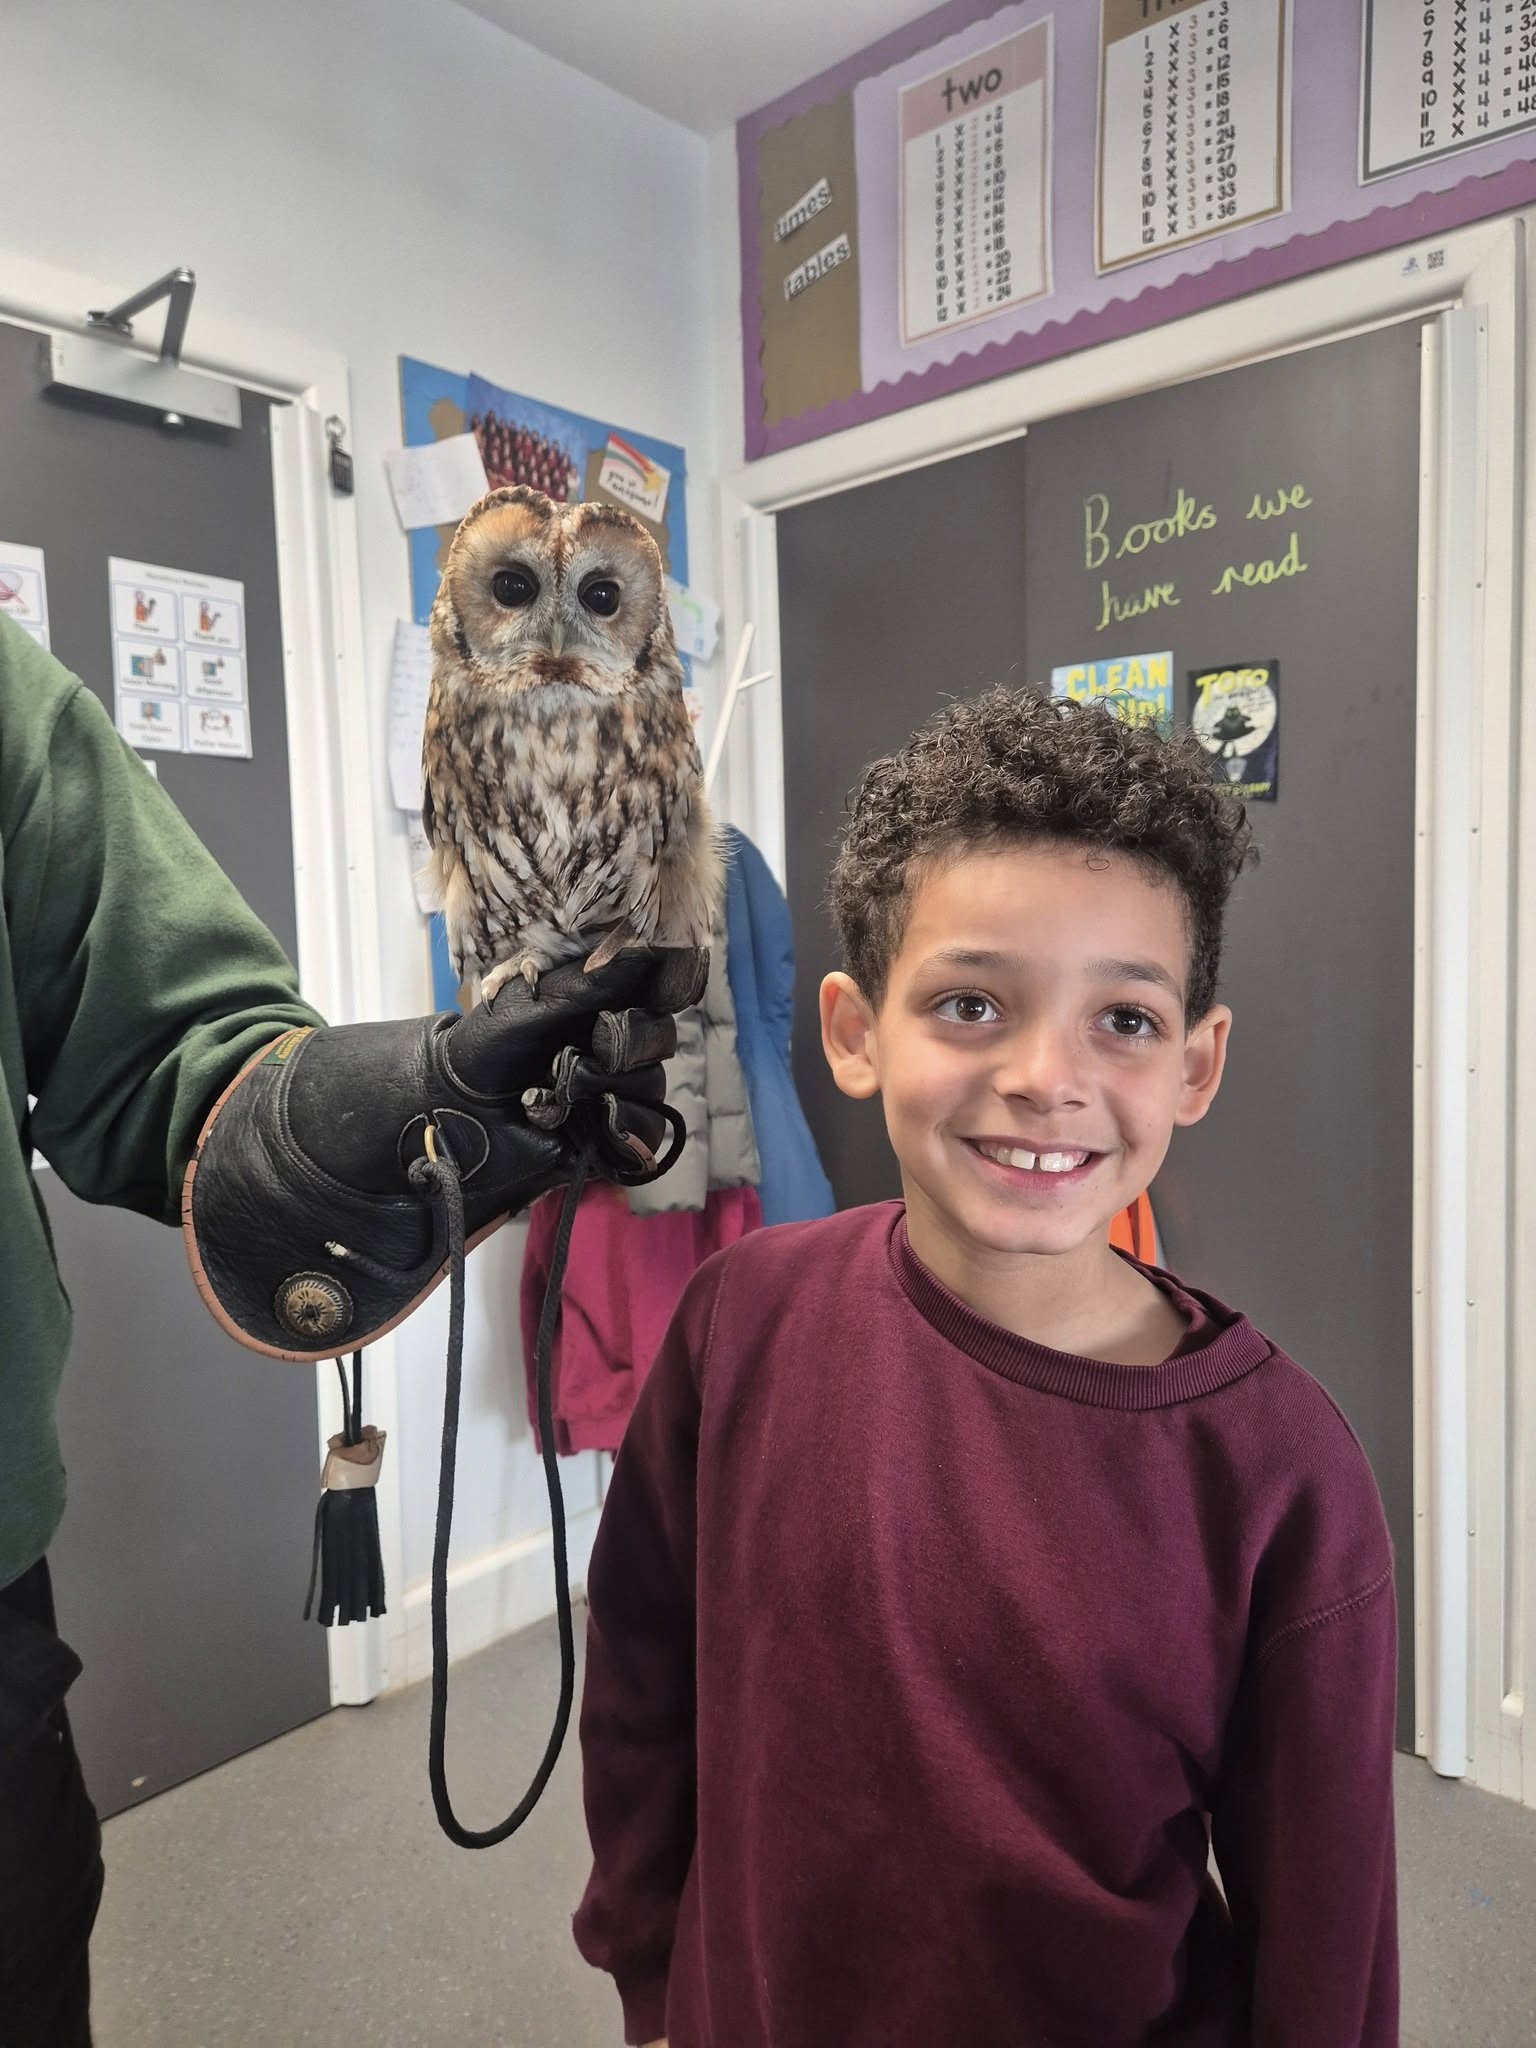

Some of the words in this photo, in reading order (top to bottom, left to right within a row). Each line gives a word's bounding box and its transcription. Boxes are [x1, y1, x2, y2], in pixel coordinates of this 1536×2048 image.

[1189, 14, 1198, 29] 3
[1219, 0, 1229, 16] 3
[1423, 9, 1435, 26] 6
[1423, 30, 1433, 47] 7
[1480, 8, 1491, 24] 4
[1144, 69, 1153, 84] 3
[1187, 50, 1196, 65] 3
[1218, 36, 1228, 51] 9
[1145, 52, 1154, 66] 2
[1188, 32, 1197, 47] 3
[1218, 18, 1229, 34] 6
[1422, 50, 1433, 67] 8
[1479, 28, 1491, 45] 4
[1144, 86, 1153, 100] 4
[1187, 68, 1196, 83] 3
[1217, 53, 1231, 72] 12
[1421, 89, 1437, 108] 10
[1478, 70, 1490, 86] 4
[1422, 69, 1434, 86] 9
[1479, 49, 1491, 66] 4
[941, 68, 1003, 113] two
[1143, 103, 1152, 119] 5
[1186, 86, 1196, 101] 3
[1217, 72, 1230, 90] 15
[1143, 121, 1152, 136] 6
[1186, 104, 1195, 119] 3
[1216, 90, 1230, 108] 18
[1421, 111, 1429, 128] 11
[1478, 91, 1489, 107] 4
[1142, 138, 1151, 154] 7
[1186, 122, 1195, 137] 3
[1216, 108, 1230, 126] 21
[1142, 156, 1152, 172] 8
[1186, 140, 1195, 156] 3
[1216, 124, 1236, 145] 24
[1420, 130, 1435, 148] 12
[1477, 112, 1489, 128] 4
[1142, 174, 1152, 189] 9
[1186, 158, 1195, 174] 3
[1216, 143, 1235, 164] 27
[1142, 191, 1156, 208] 10
[1187, 178, 1196, 192] 3
[1217, 162, 1237, 182] 30
[1187, 196, 1196, 211] 3
[1217, 181, 1236, 201] 33
[1143, 227, 1155, 244] 12
[1188, 214, 1197, 229] 3
[1217, 199, 1237, 219] 36
[785, 243, 849, 297] tables
[1084, 488, 1218, 570] Books
[1246, 484, 1313, 520] we
[1096, 581, 1181, 631] have
[1212, 532, 1309, 595] read
[1066, 656, 1168, 701] CLEAN
[1195, 668, 1269, 706] TOTO
